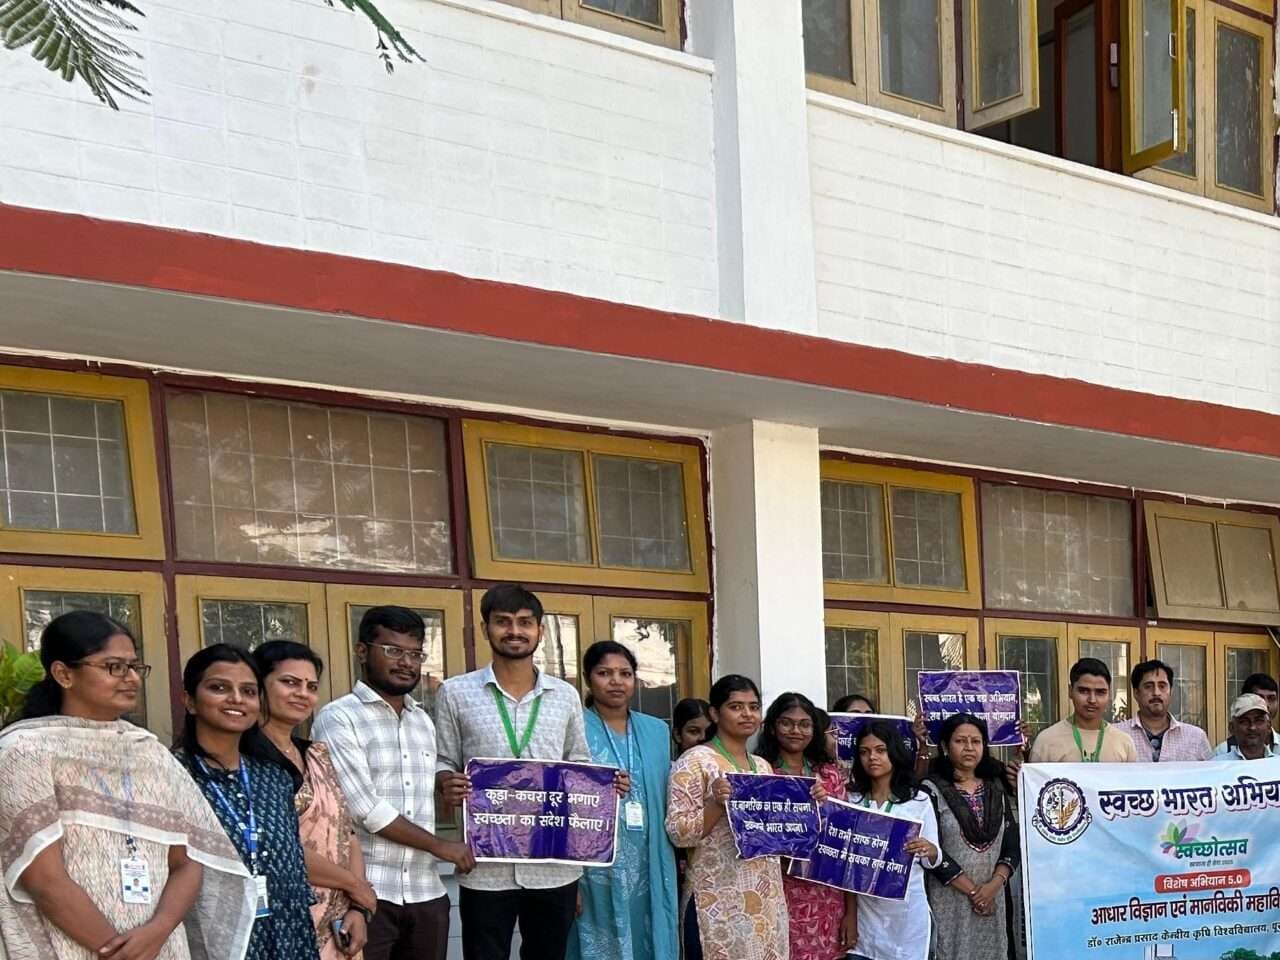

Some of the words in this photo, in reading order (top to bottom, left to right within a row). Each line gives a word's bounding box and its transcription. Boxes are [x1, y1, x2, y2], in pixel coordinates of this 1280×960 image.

[548, 791, 564, 808] दूर
[1098, 789, 1155, 815] स्वच्छ
[1161, 786, 1213, 812] भारत
[472, 813, 517, 826] स्वच्छता
[519, 813, 536, 827] का
[1175, 836, 1249, 859] स्वच्छोत्सव
[1163, 876, 1188, 889] विशेष
[1190, 874, 1226, 888] अभियान
[1228, 874, 1242, 885] 5.0
[1091, 905, 1128, 925] आधार
[1128, 896, 1168, 922] विज्ञान
[1170, 893, 1187, 919] एवं
[1189, 889, 1243, 916] मानविकी
[1134, 932, 1158, 943] प्रसाद
